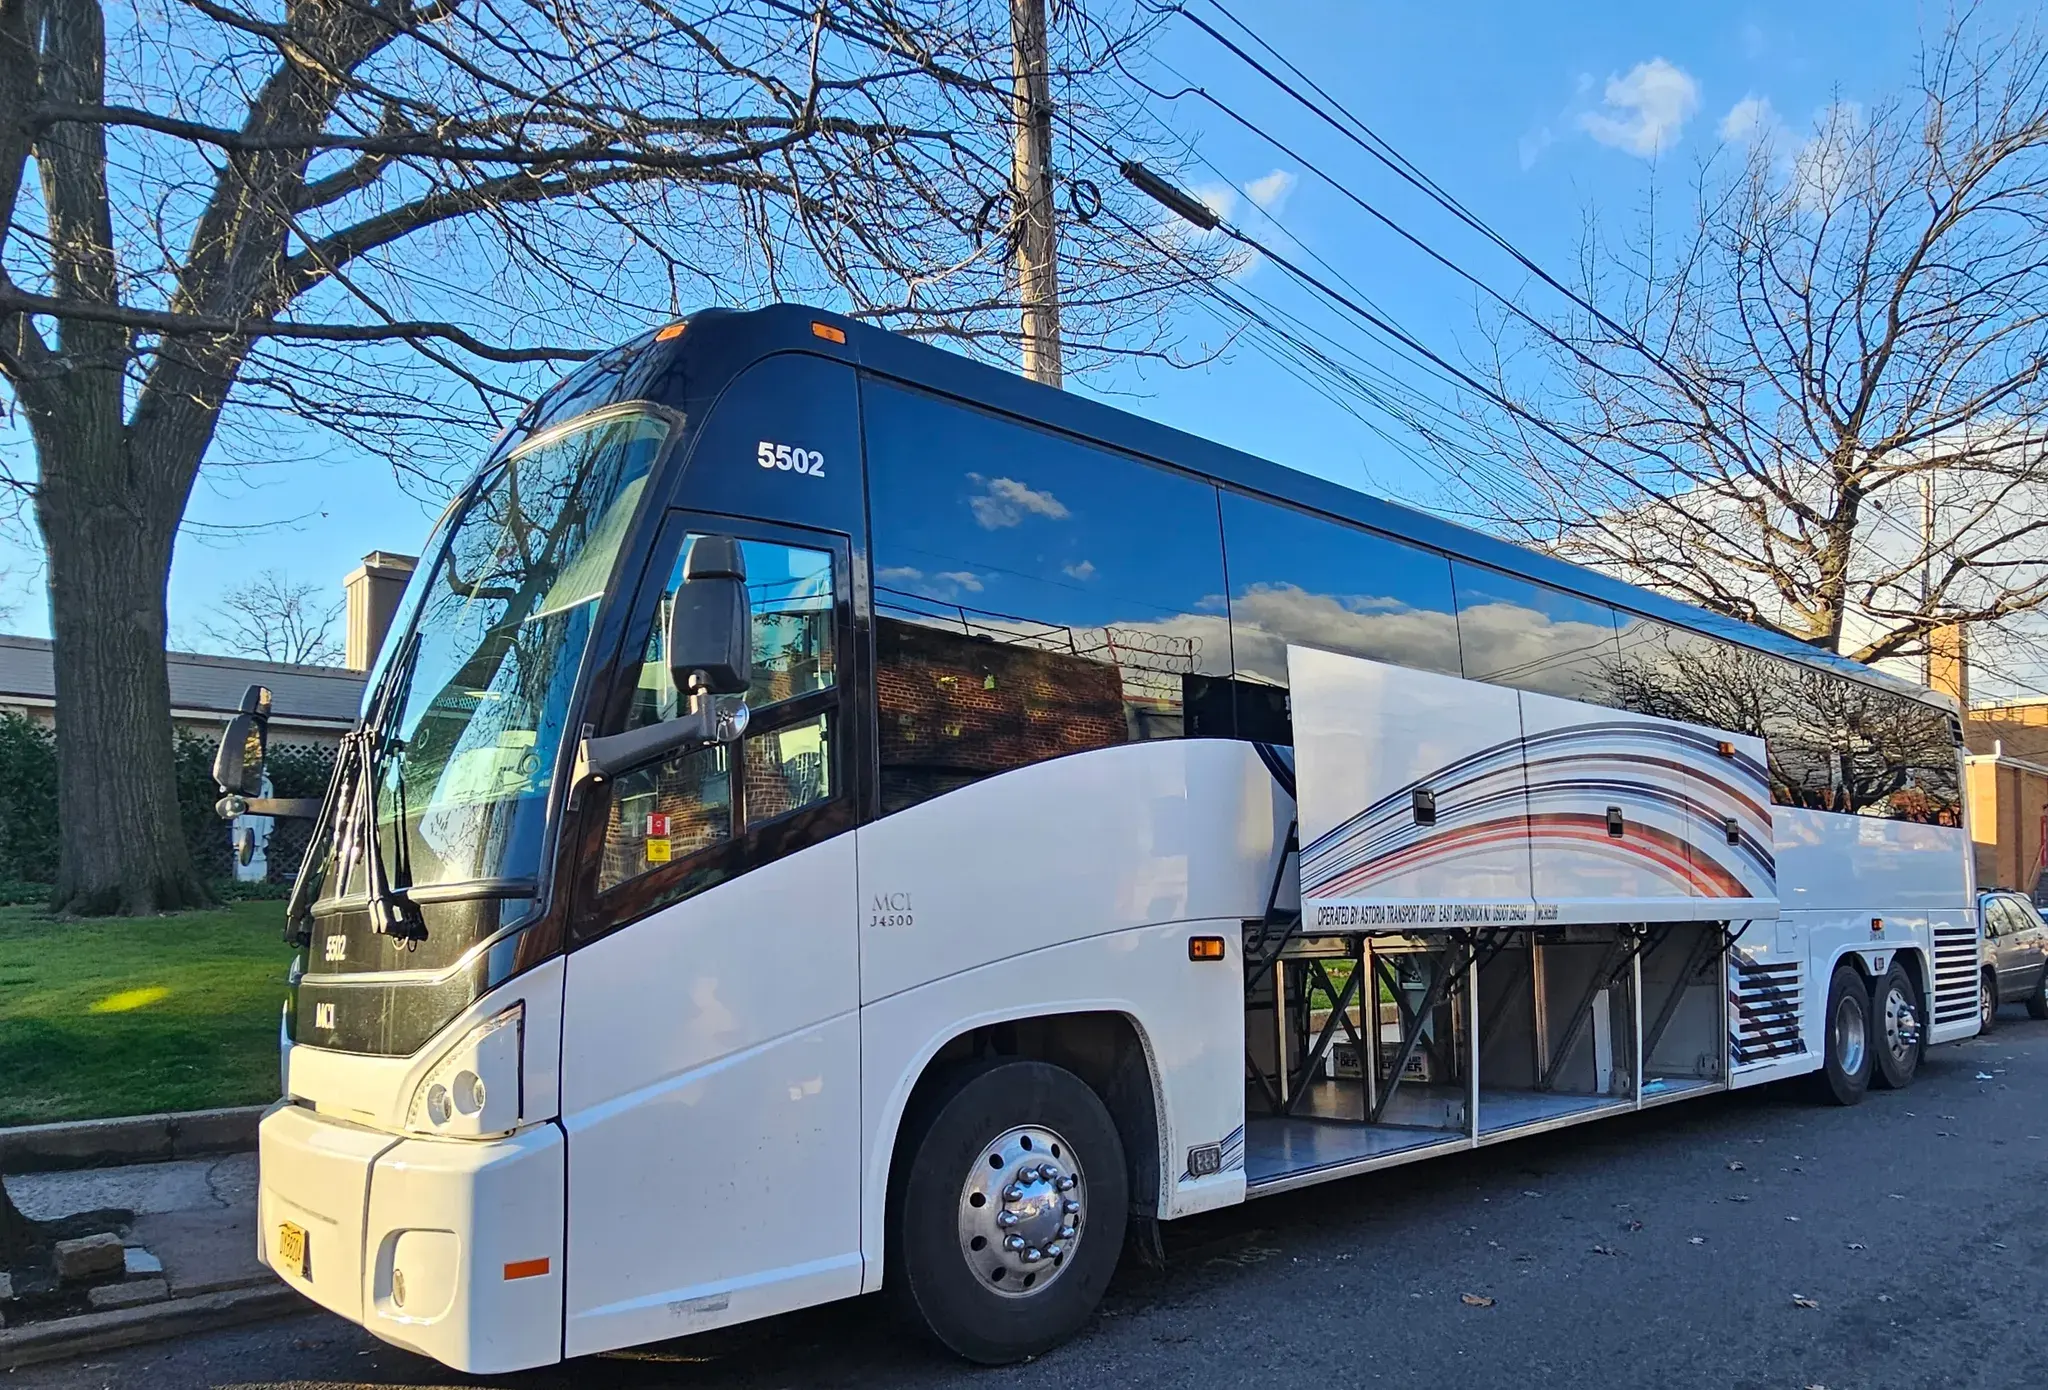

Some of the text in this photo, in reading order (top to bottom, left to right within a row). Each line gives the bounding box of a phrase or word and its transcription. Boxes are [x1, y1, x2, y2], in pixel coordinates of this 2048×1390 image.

[758, 441, 825, 478] 5502
[872, 892, 912, 911] MCI
[870, 914, 913, 927] J4500
[1318, 906, 1349, 925] OPERATED
[1360, 905, 1385, 924] ASTORIA
[1387, 905, 1419, 923] TRANSPORT
[1439, 905, 1453, 922] EAST
[1454, 904, 1482, 922] BRUNSWICK
[325, 934, 347, 962] 5502
[315, 1002, 335, 1029] MCI
